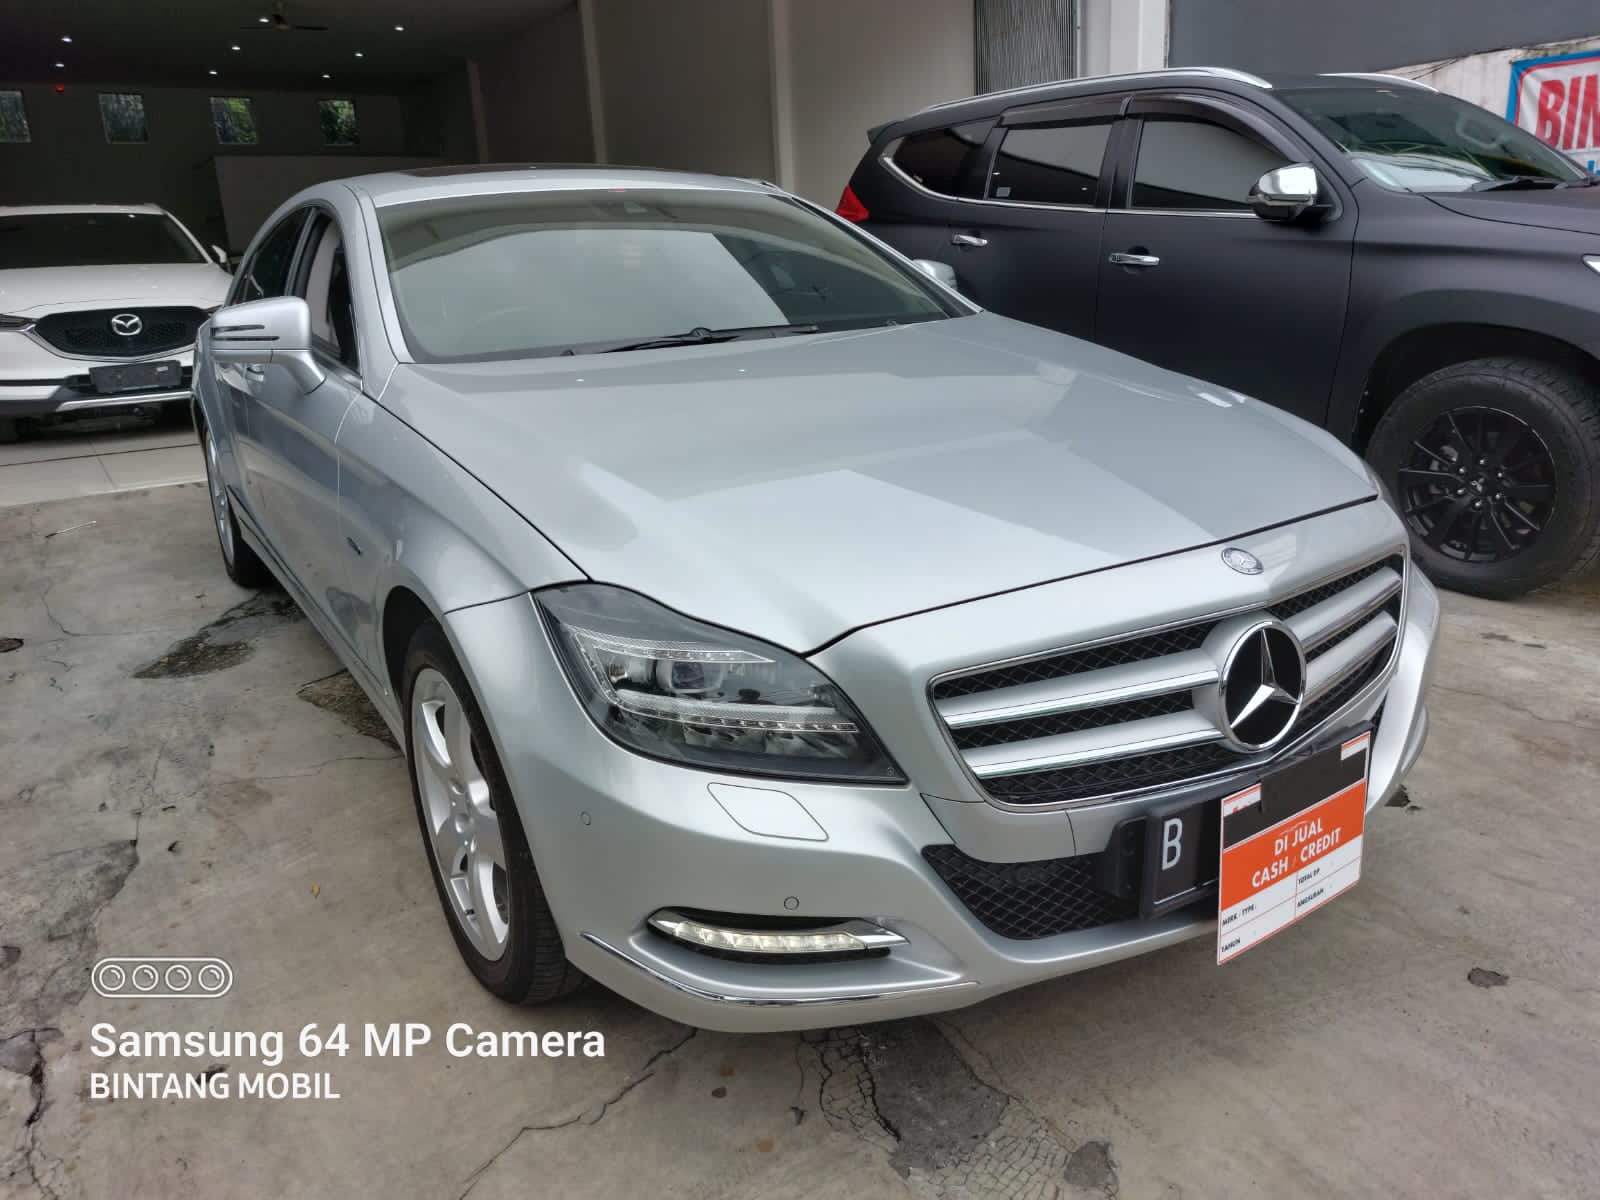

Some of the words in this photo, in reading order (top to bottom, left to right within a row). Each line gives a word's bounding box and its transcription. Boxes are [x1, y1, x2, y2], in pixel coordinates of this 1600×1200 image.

[1161, 818, 1183, 871] B
[1251, 855, 1289, 888] CASH
[1300, 827, 1341, 862] CREDIT
[1274, 834, 1288, 856] DI
[1291, 817, 1323, 847] JUAL
